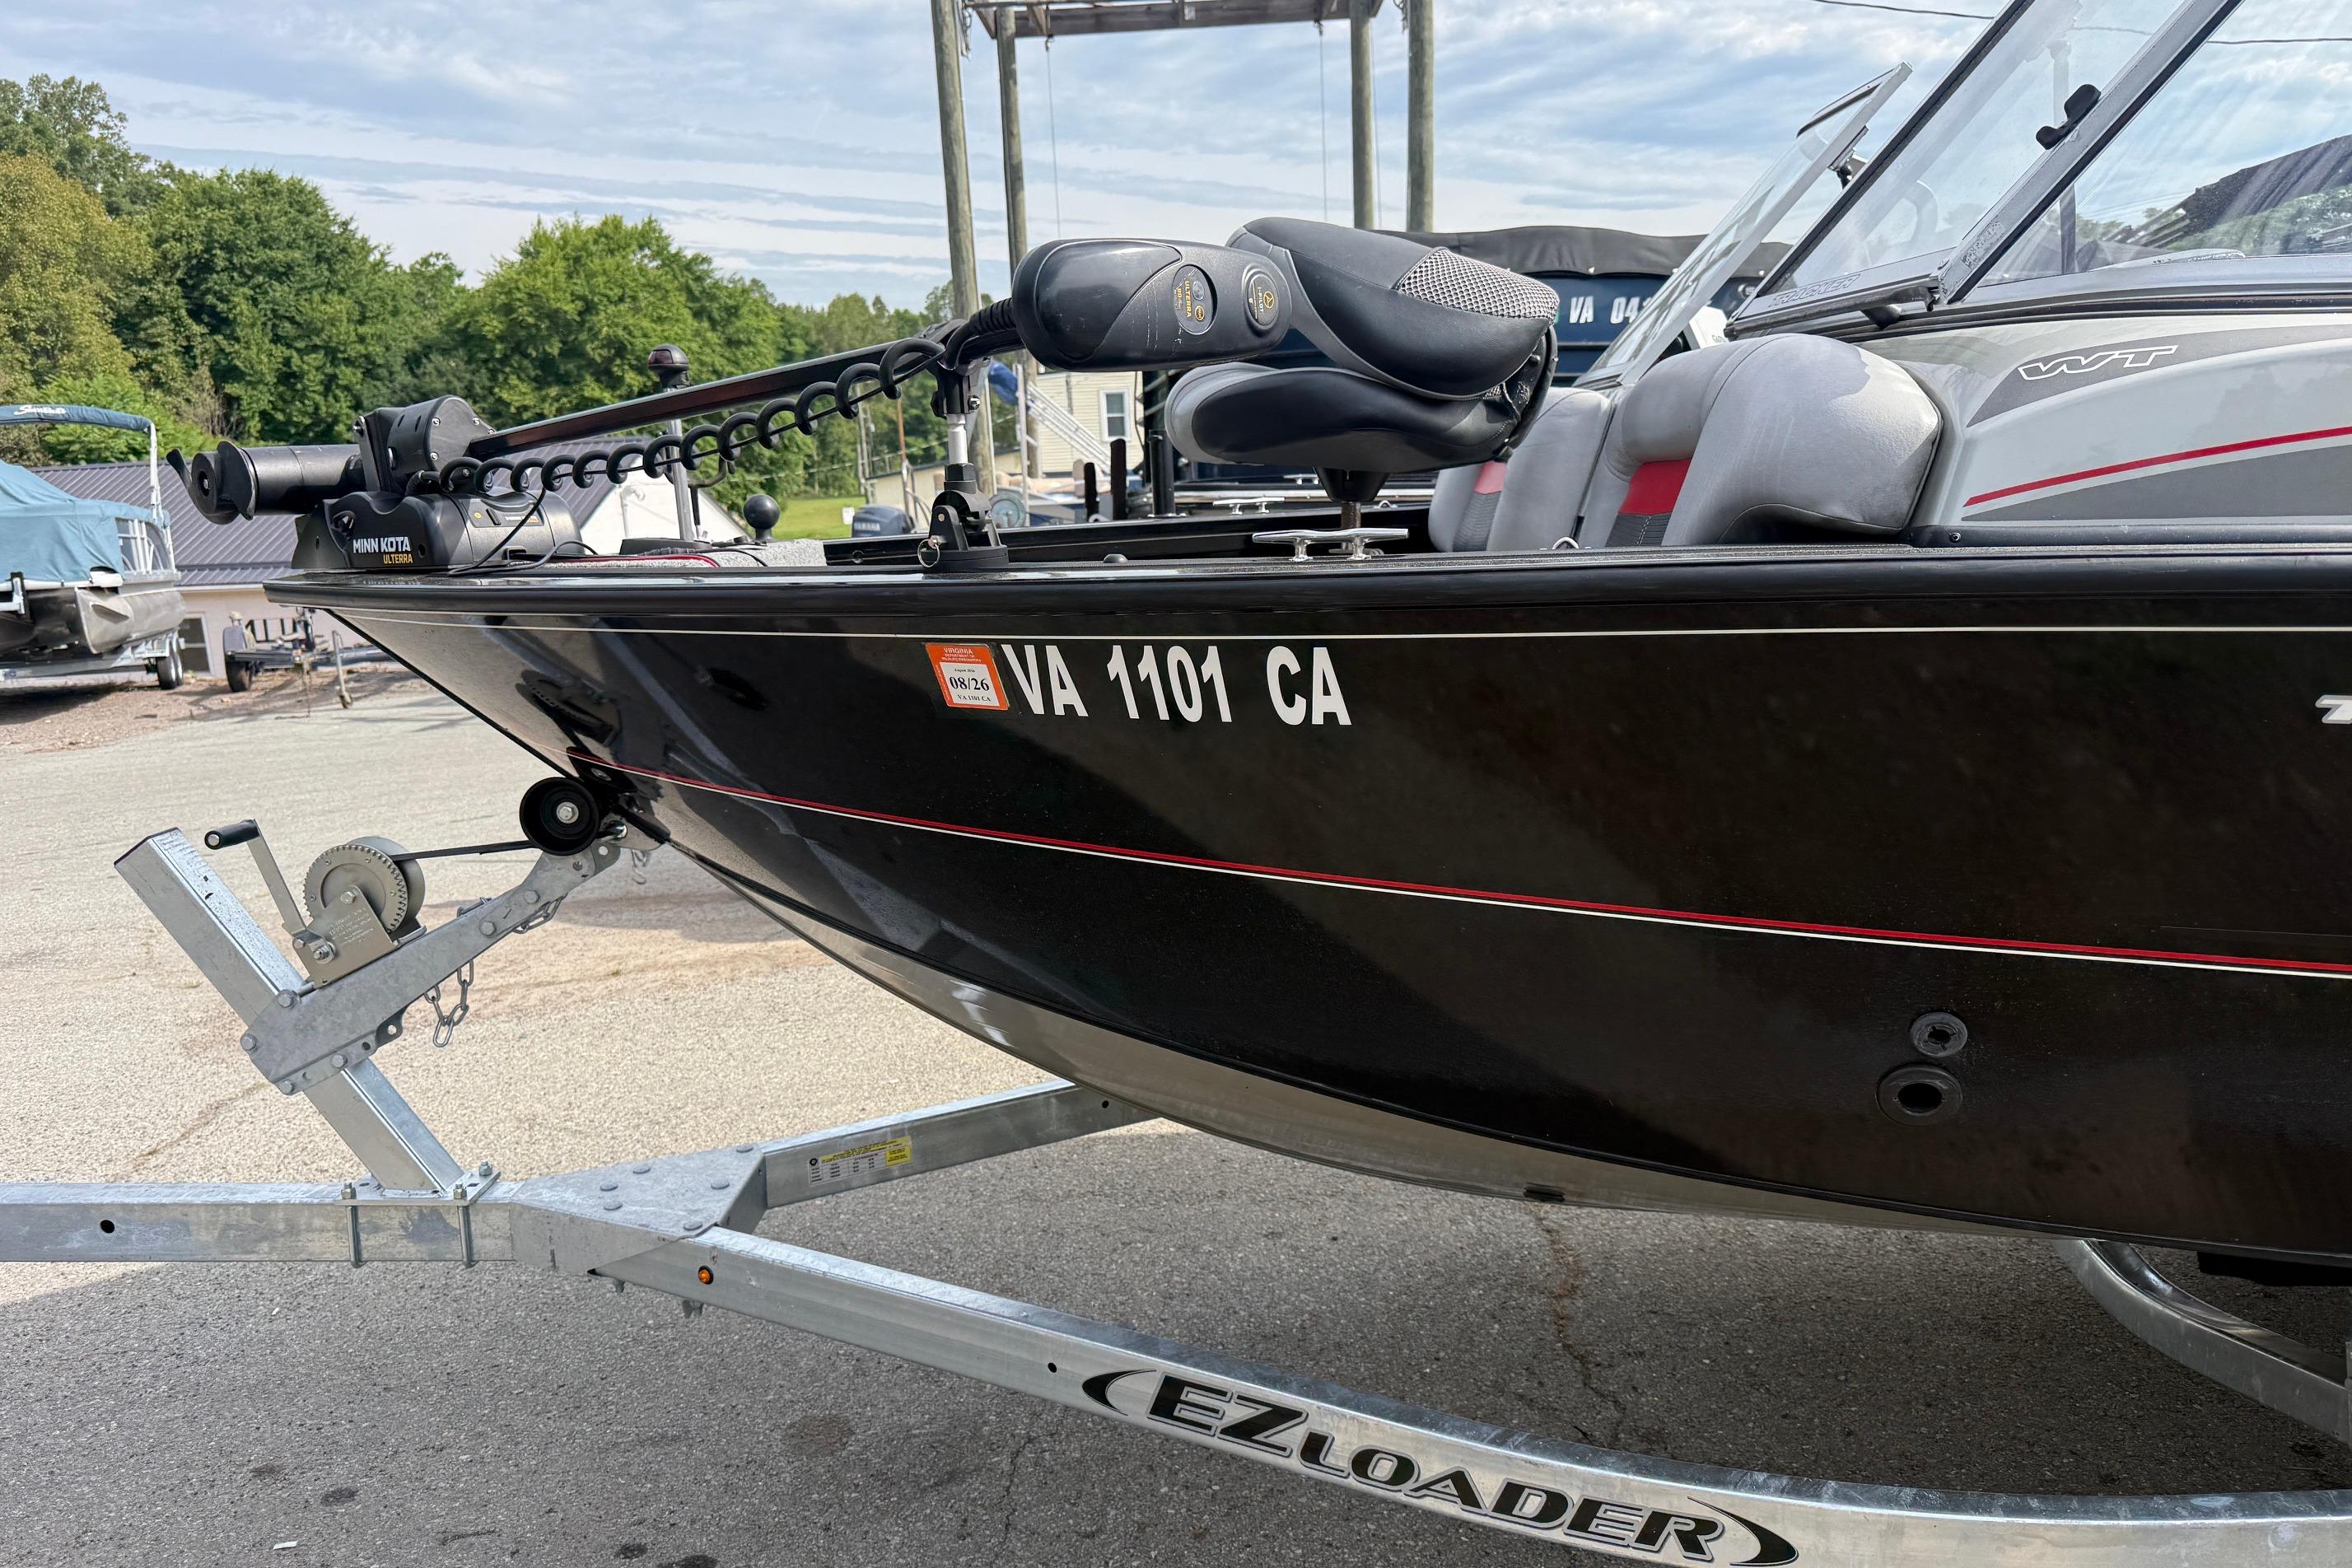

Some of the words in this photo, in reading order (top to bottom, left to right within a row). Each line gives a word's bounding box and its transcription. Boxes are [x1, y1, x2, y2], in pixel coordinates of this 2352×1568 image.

[1570, 296, 1594, 324] VA
[2018, 343, 2179, 380] WT
[352, 538, 379, 553] MINN
[380, 536, 411, 553] KOTA
[383, 553, 413, 564] ULTERRA
[950, 676, 990, 692] 08/26
[1001, 644, 1089, 717] VA
[1107, 645, 1232, 723] 1101
[1267, 646, 1351, 726] CA
